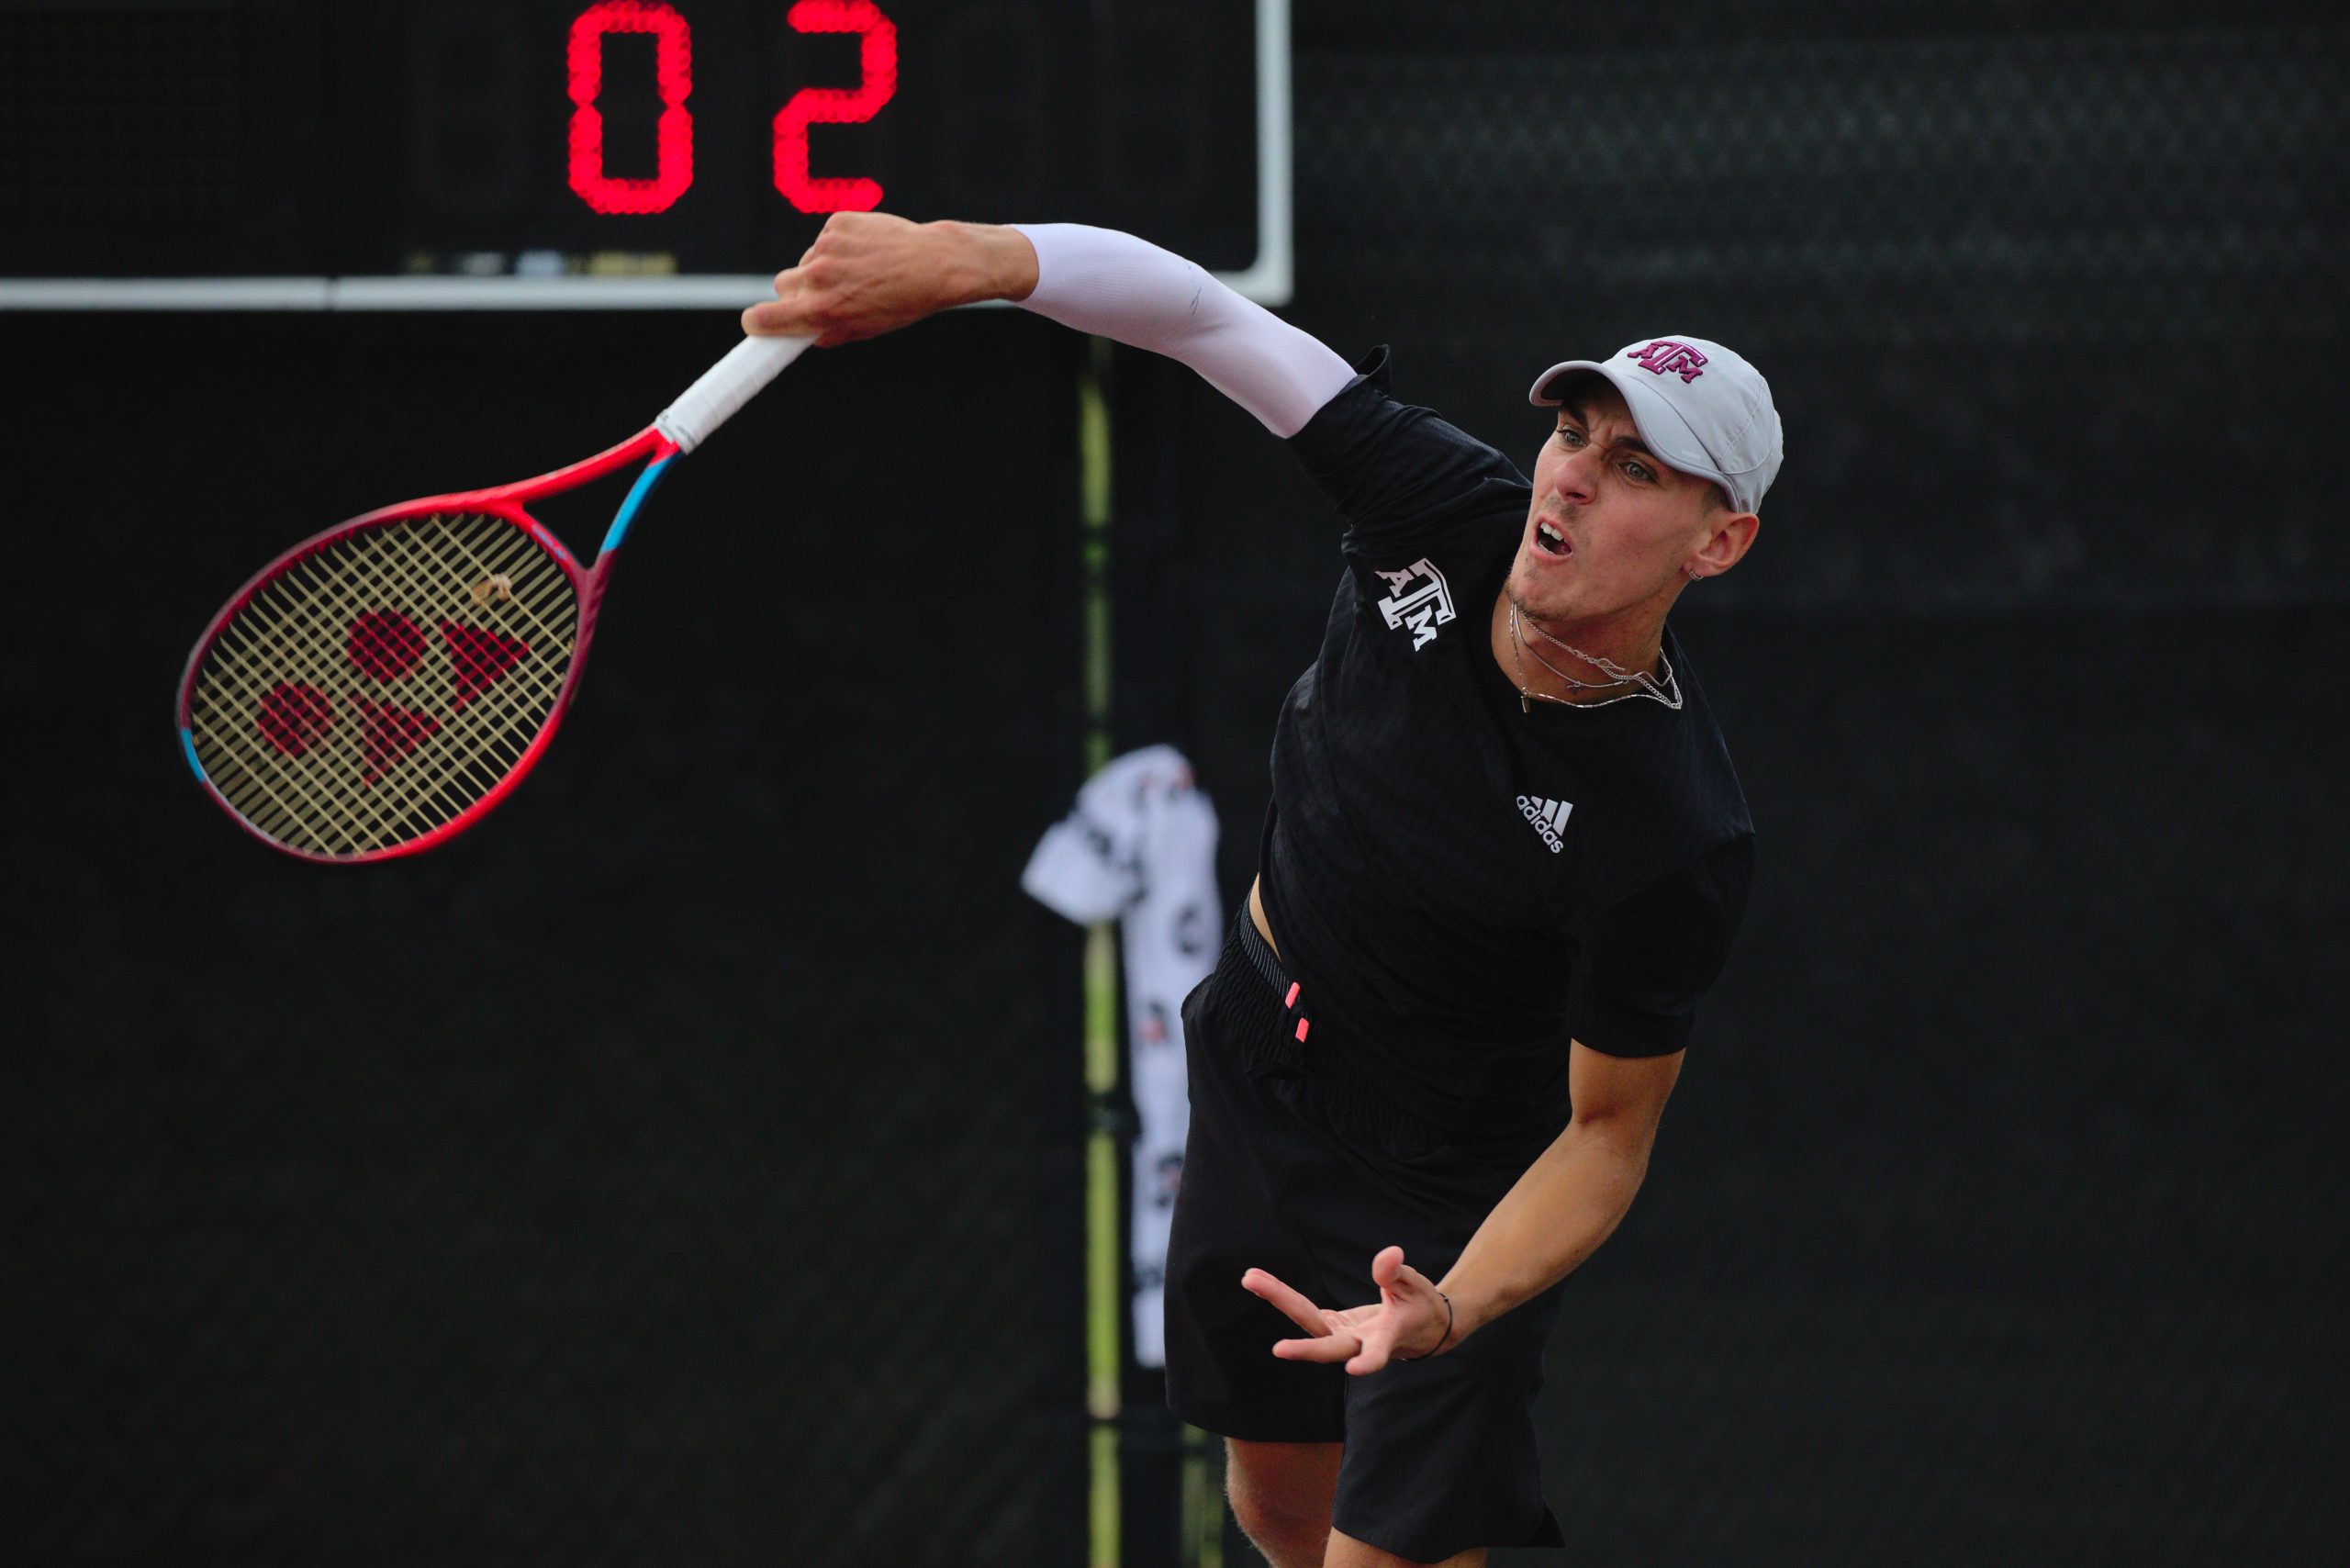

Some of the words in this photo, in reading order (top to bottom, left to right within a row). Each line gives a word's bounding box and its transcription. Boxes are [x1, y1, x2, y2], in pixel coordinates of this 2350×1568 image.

[566, 0, 694, 215] 0
[772, 0, 899, 214] 2
[1516, 794, 1564, 854] adidas
